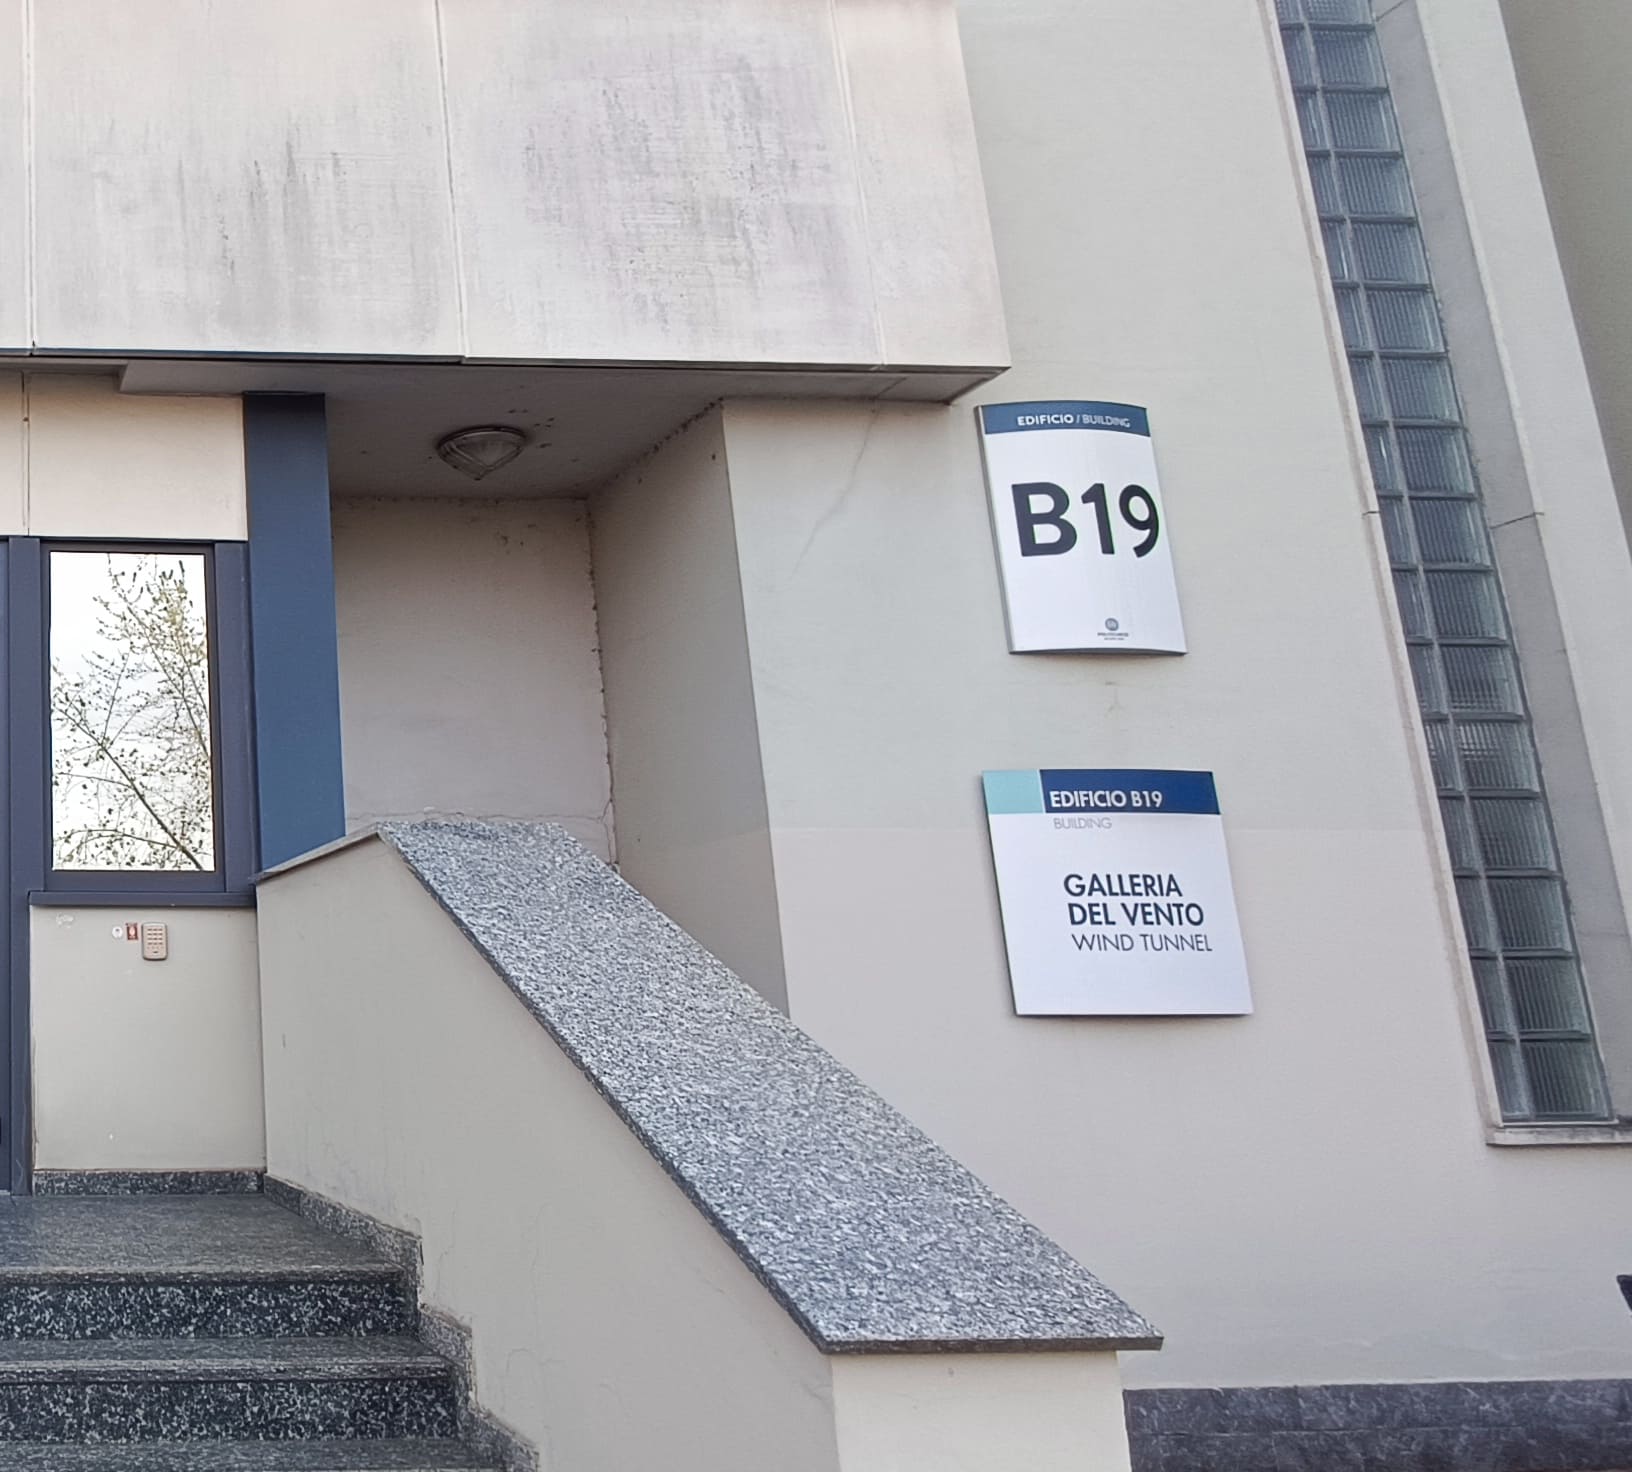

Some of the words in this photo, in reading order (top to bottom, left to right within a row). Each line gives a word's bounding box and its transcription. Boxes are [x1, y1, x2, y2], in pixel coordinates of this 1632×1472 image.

[1017, 414, 1074, 426] EDIFICIO
[1082, 414, 1131, 428] BUILDING
[1011, 481, 1160, 558] B19
[1049, 790, 1126, 808] EDIFICIO
[1131, 790, 1163, 808] B19
[1053, 817, 1113, 830] BUILDING
[1063, 873, 1183, 897] GALLERIA
[1068, 902, 1116, 926] DEL
[1121, 902, 1204, 926] VENTO
[1071, 933, 1135, 951] WIND
[1139, 933, 1213, 952] TUNNEL
